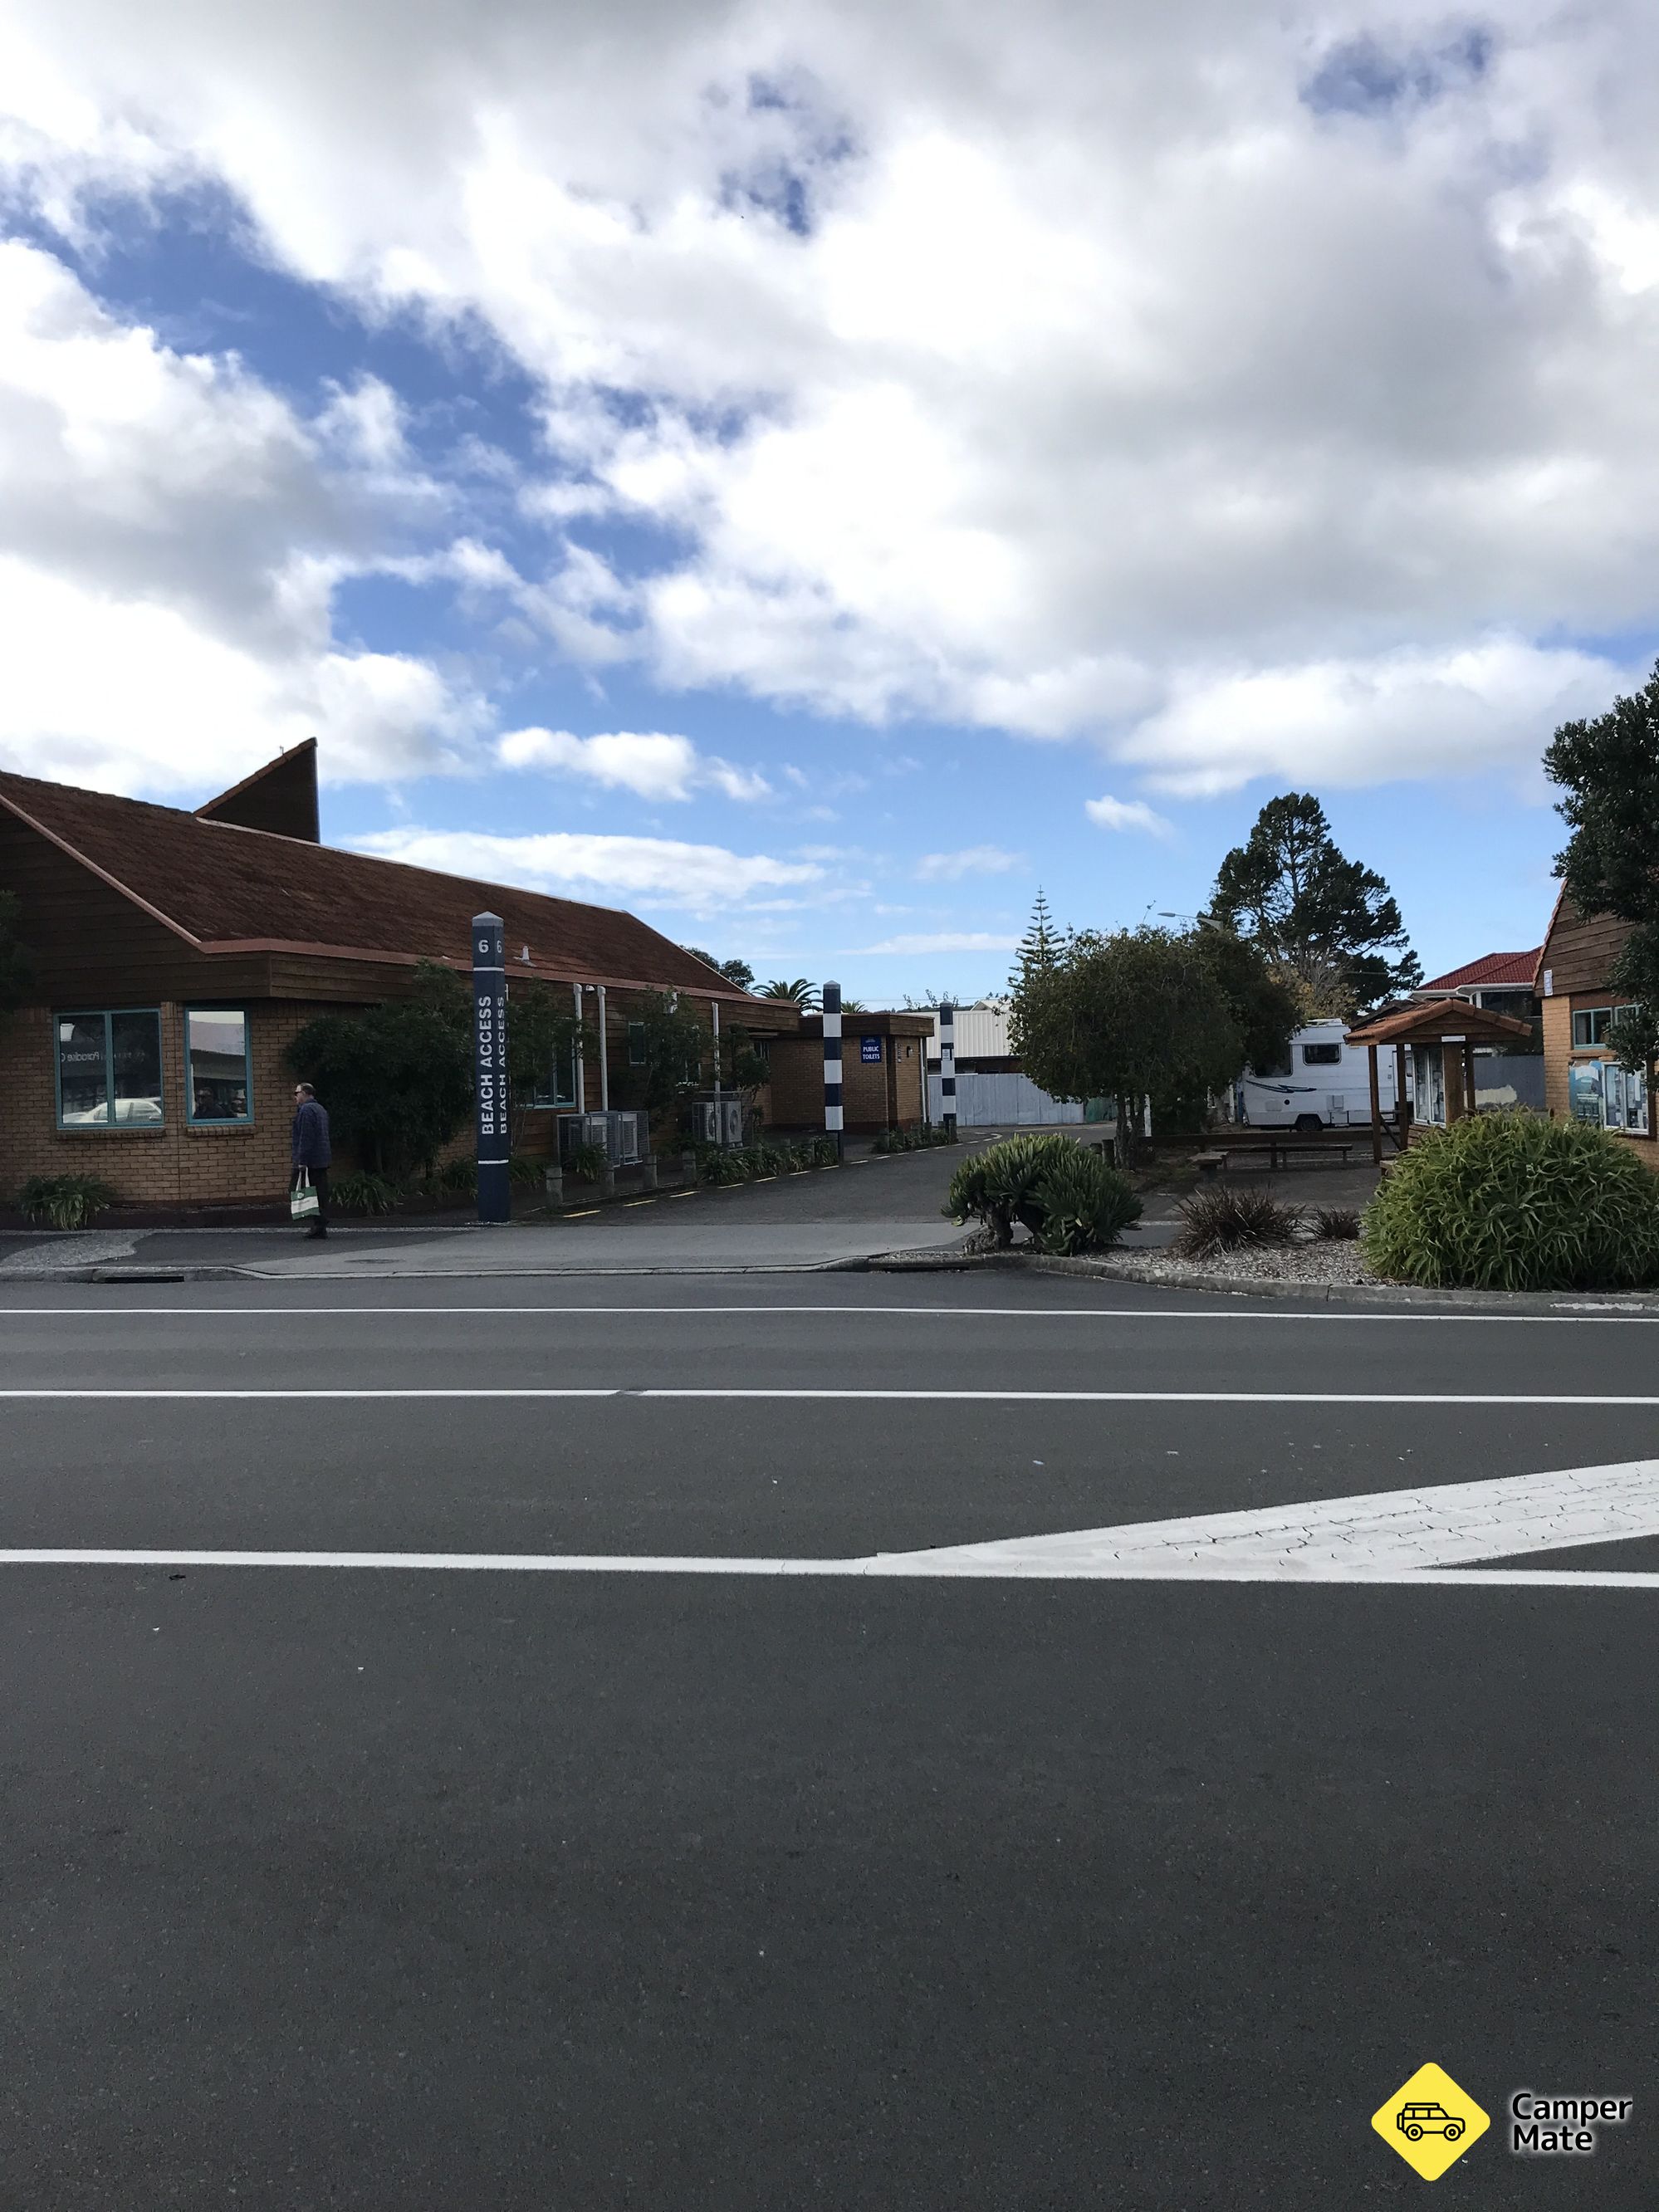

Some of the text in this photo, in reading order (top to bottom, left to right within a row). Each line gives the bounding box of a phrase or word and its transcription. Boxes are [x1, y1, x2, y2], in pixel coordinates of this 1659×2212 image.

[478, 939, 489, 953] 6
[497, 939, 502, 954] 6
[478, 996, 494, 1135] BEACH ACCESS
[497, 996, 507, 1134] BEACH ACCESS
